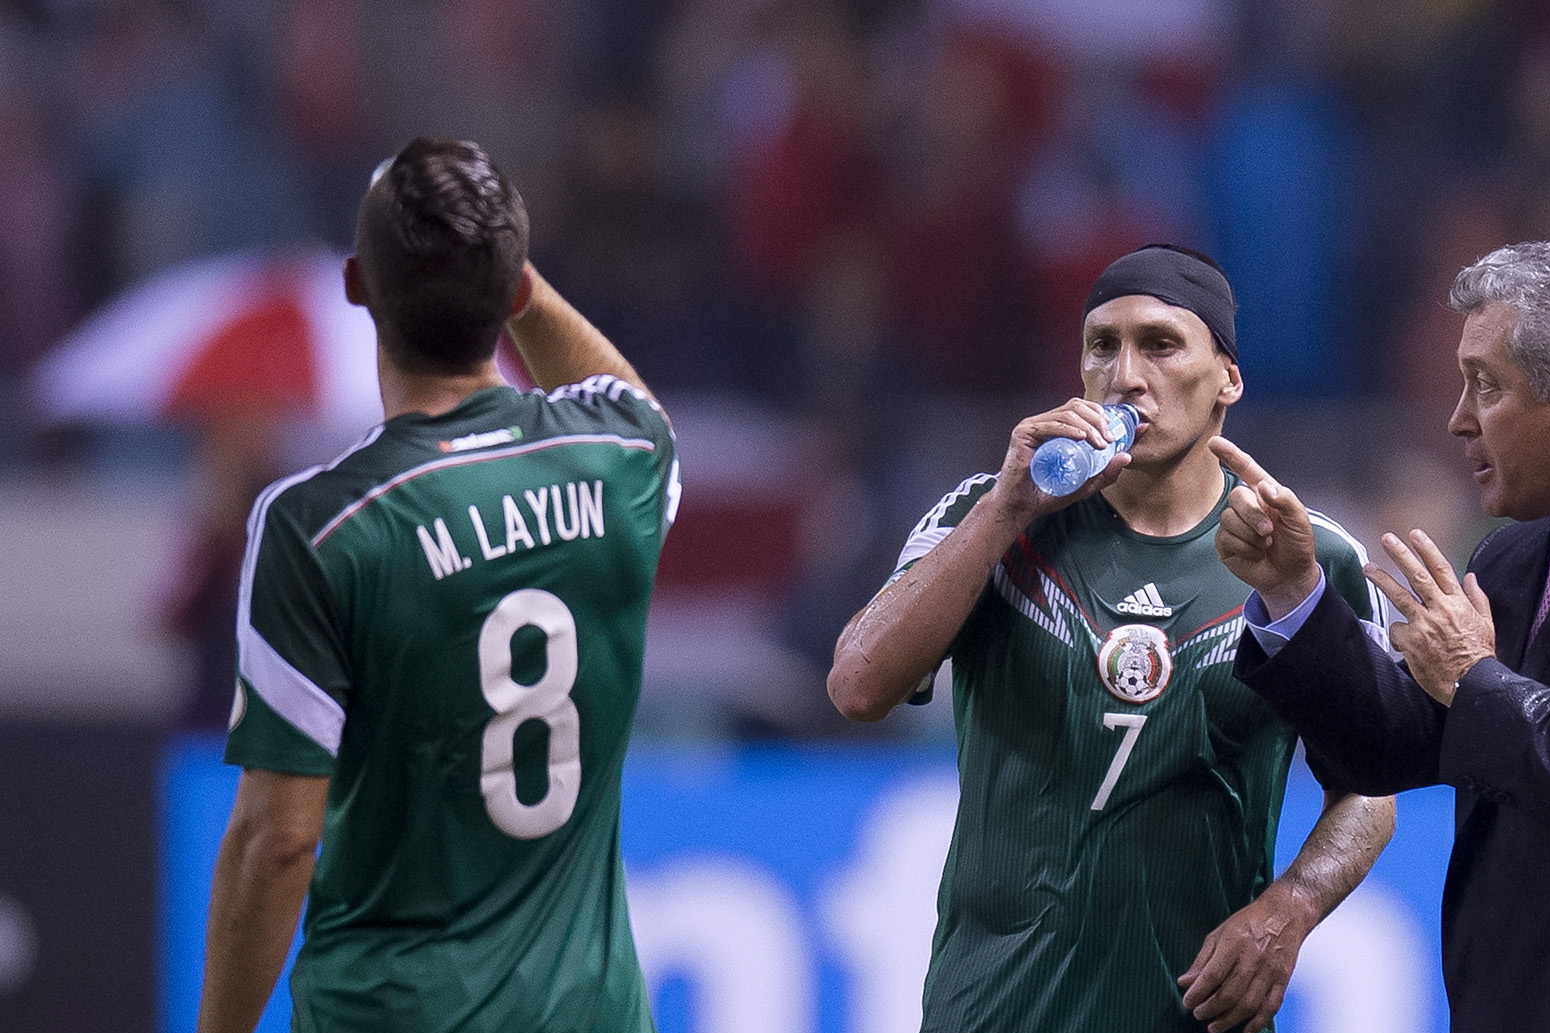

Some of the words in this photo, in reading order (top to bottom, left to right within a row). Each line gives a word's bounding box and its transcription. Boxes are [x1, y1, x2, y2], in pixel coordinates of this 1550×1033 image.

[417, 518, 472, 580] M.
[469, 480, 605, 560] LAYUN
[1117, 602, 1173, 617] adidas
[479, 588, 581, 840] 8
[1091, 713, 1148, 811] 7
